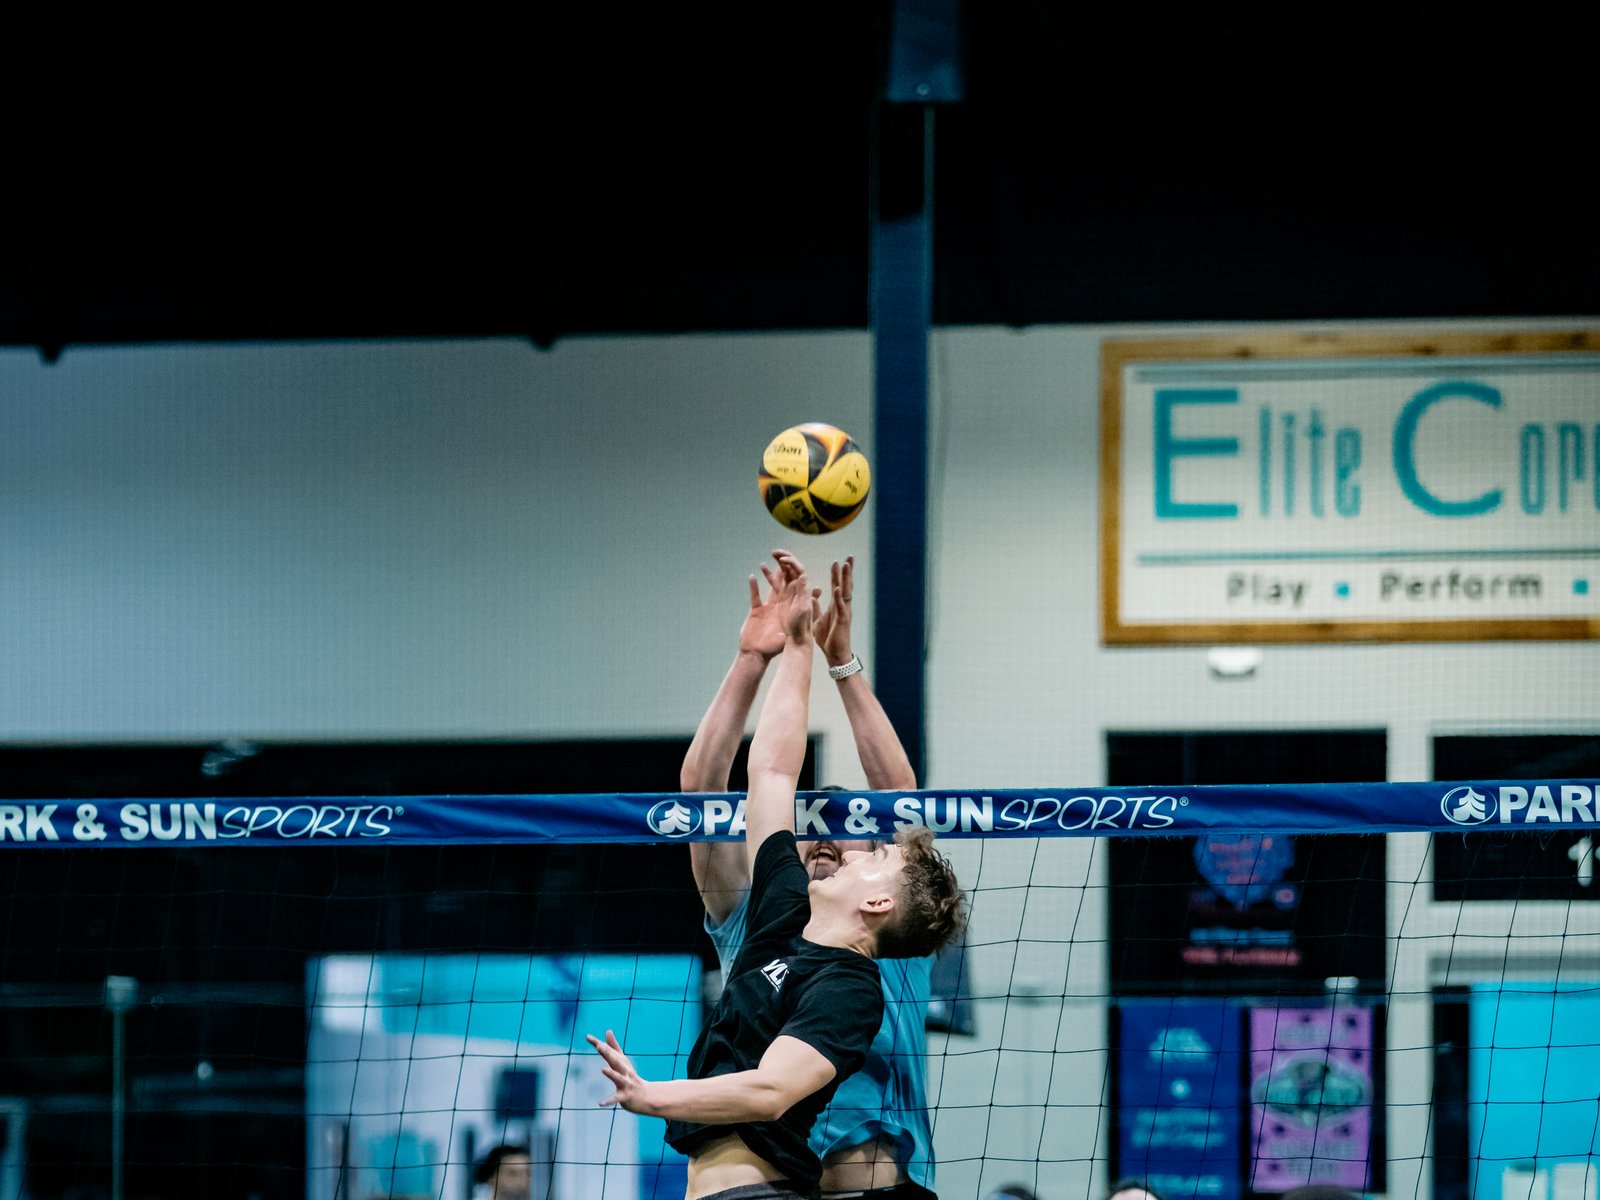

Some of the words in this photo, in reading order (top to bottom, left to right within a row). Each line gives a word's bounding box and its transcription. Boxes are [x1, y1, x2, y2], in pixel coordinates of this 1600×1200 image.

[1154, 388, 1362, 519] Elite
[1227, 572, 1308, 608] Play
[1380, 566, 1543, 602] Perform
[73, 804, 107, 841] &
[120, 803, 217, 840] SUN
[844, 797, 880, 834] &
[893, 797, 994, 833] SUN
[1499, 785, 1600, 824] PAR
